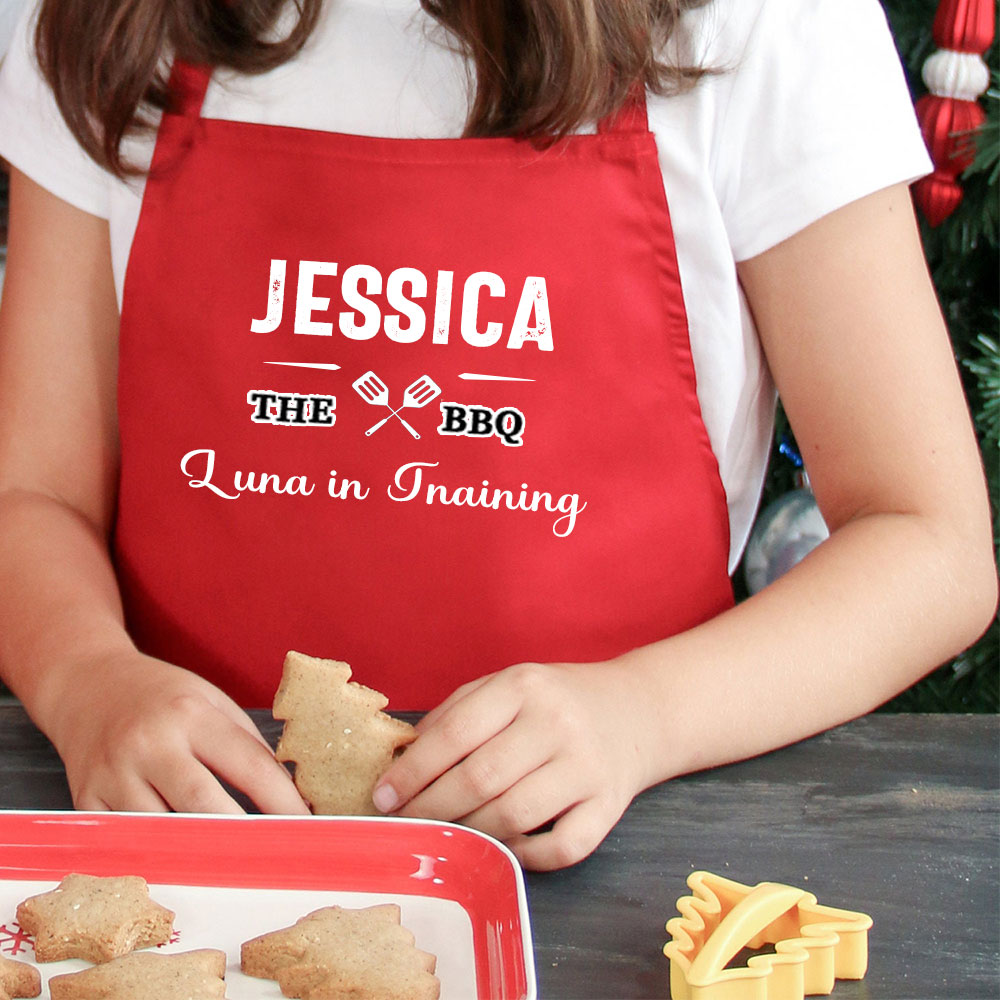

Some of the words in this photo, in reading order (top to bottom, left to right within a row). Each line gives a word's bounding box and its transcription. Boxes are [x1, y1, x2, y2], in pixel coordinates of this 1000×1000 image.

[250, 259, 554, 351] JESSICA
[247, 390, 336, 427] THE
[437, 402, 525, 447] BBQ
[180, 449, 315, 499] Luna
[328, 470, 370, 500] in
